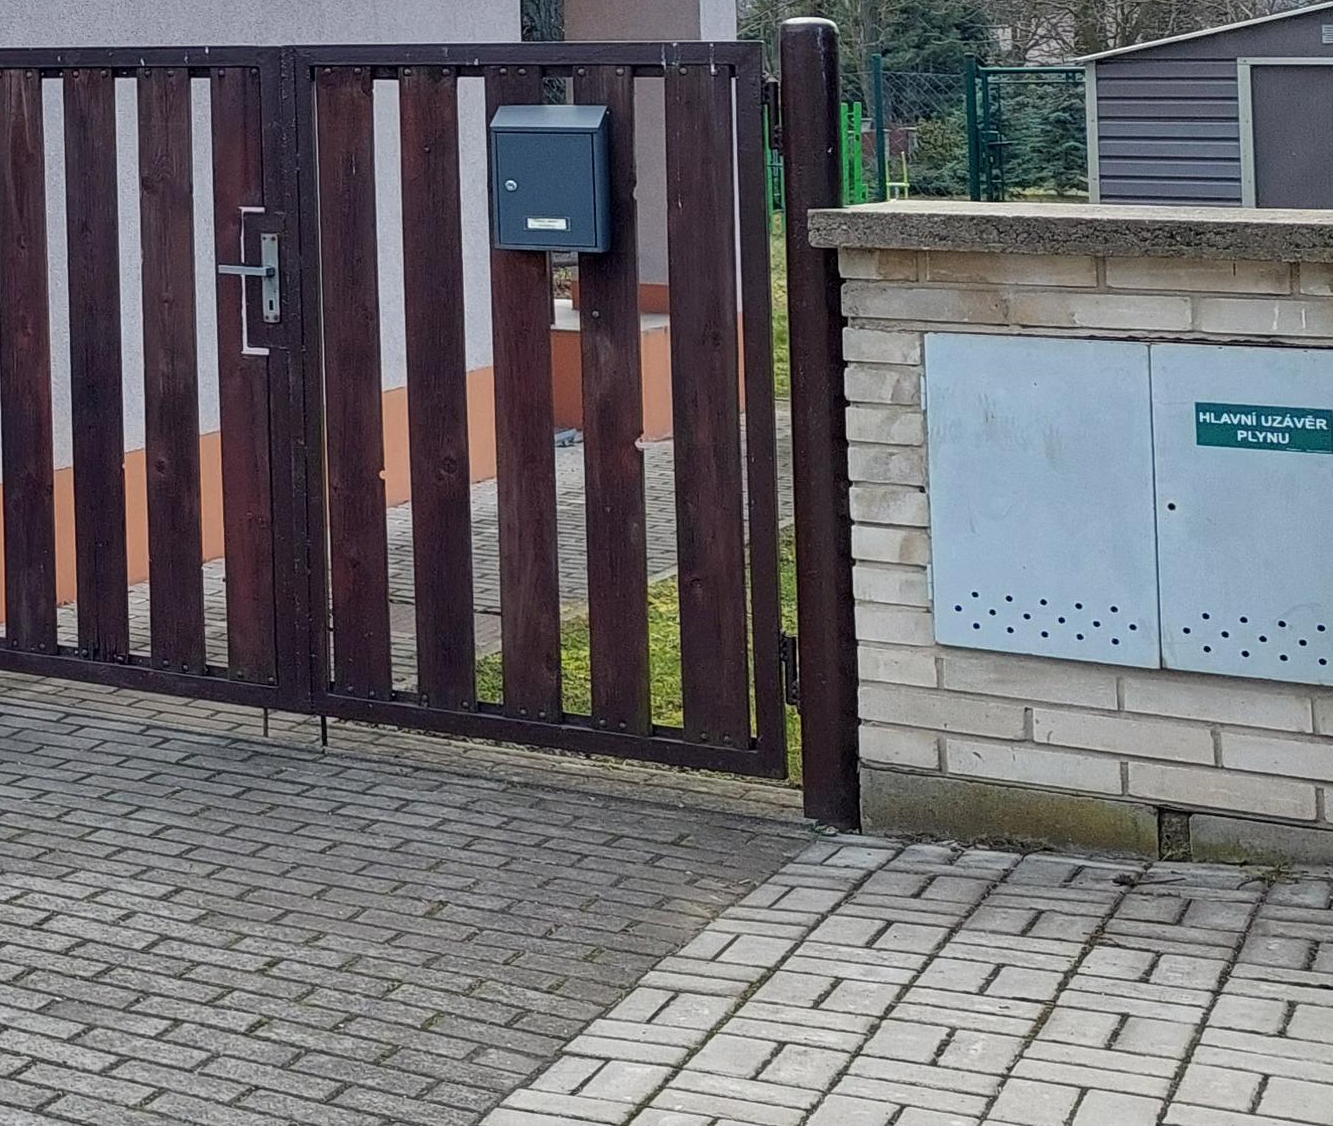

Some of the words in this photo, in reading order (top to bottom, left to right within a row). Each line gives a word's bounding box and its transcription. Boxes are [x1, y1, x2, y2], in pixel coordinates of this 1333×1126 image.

[1199, 412, 1257, 426] HLAVNÍ
[1261, 414, 1328, 430] UZÁVĚR
[1237, 429, 1290, 444] PLYNU
